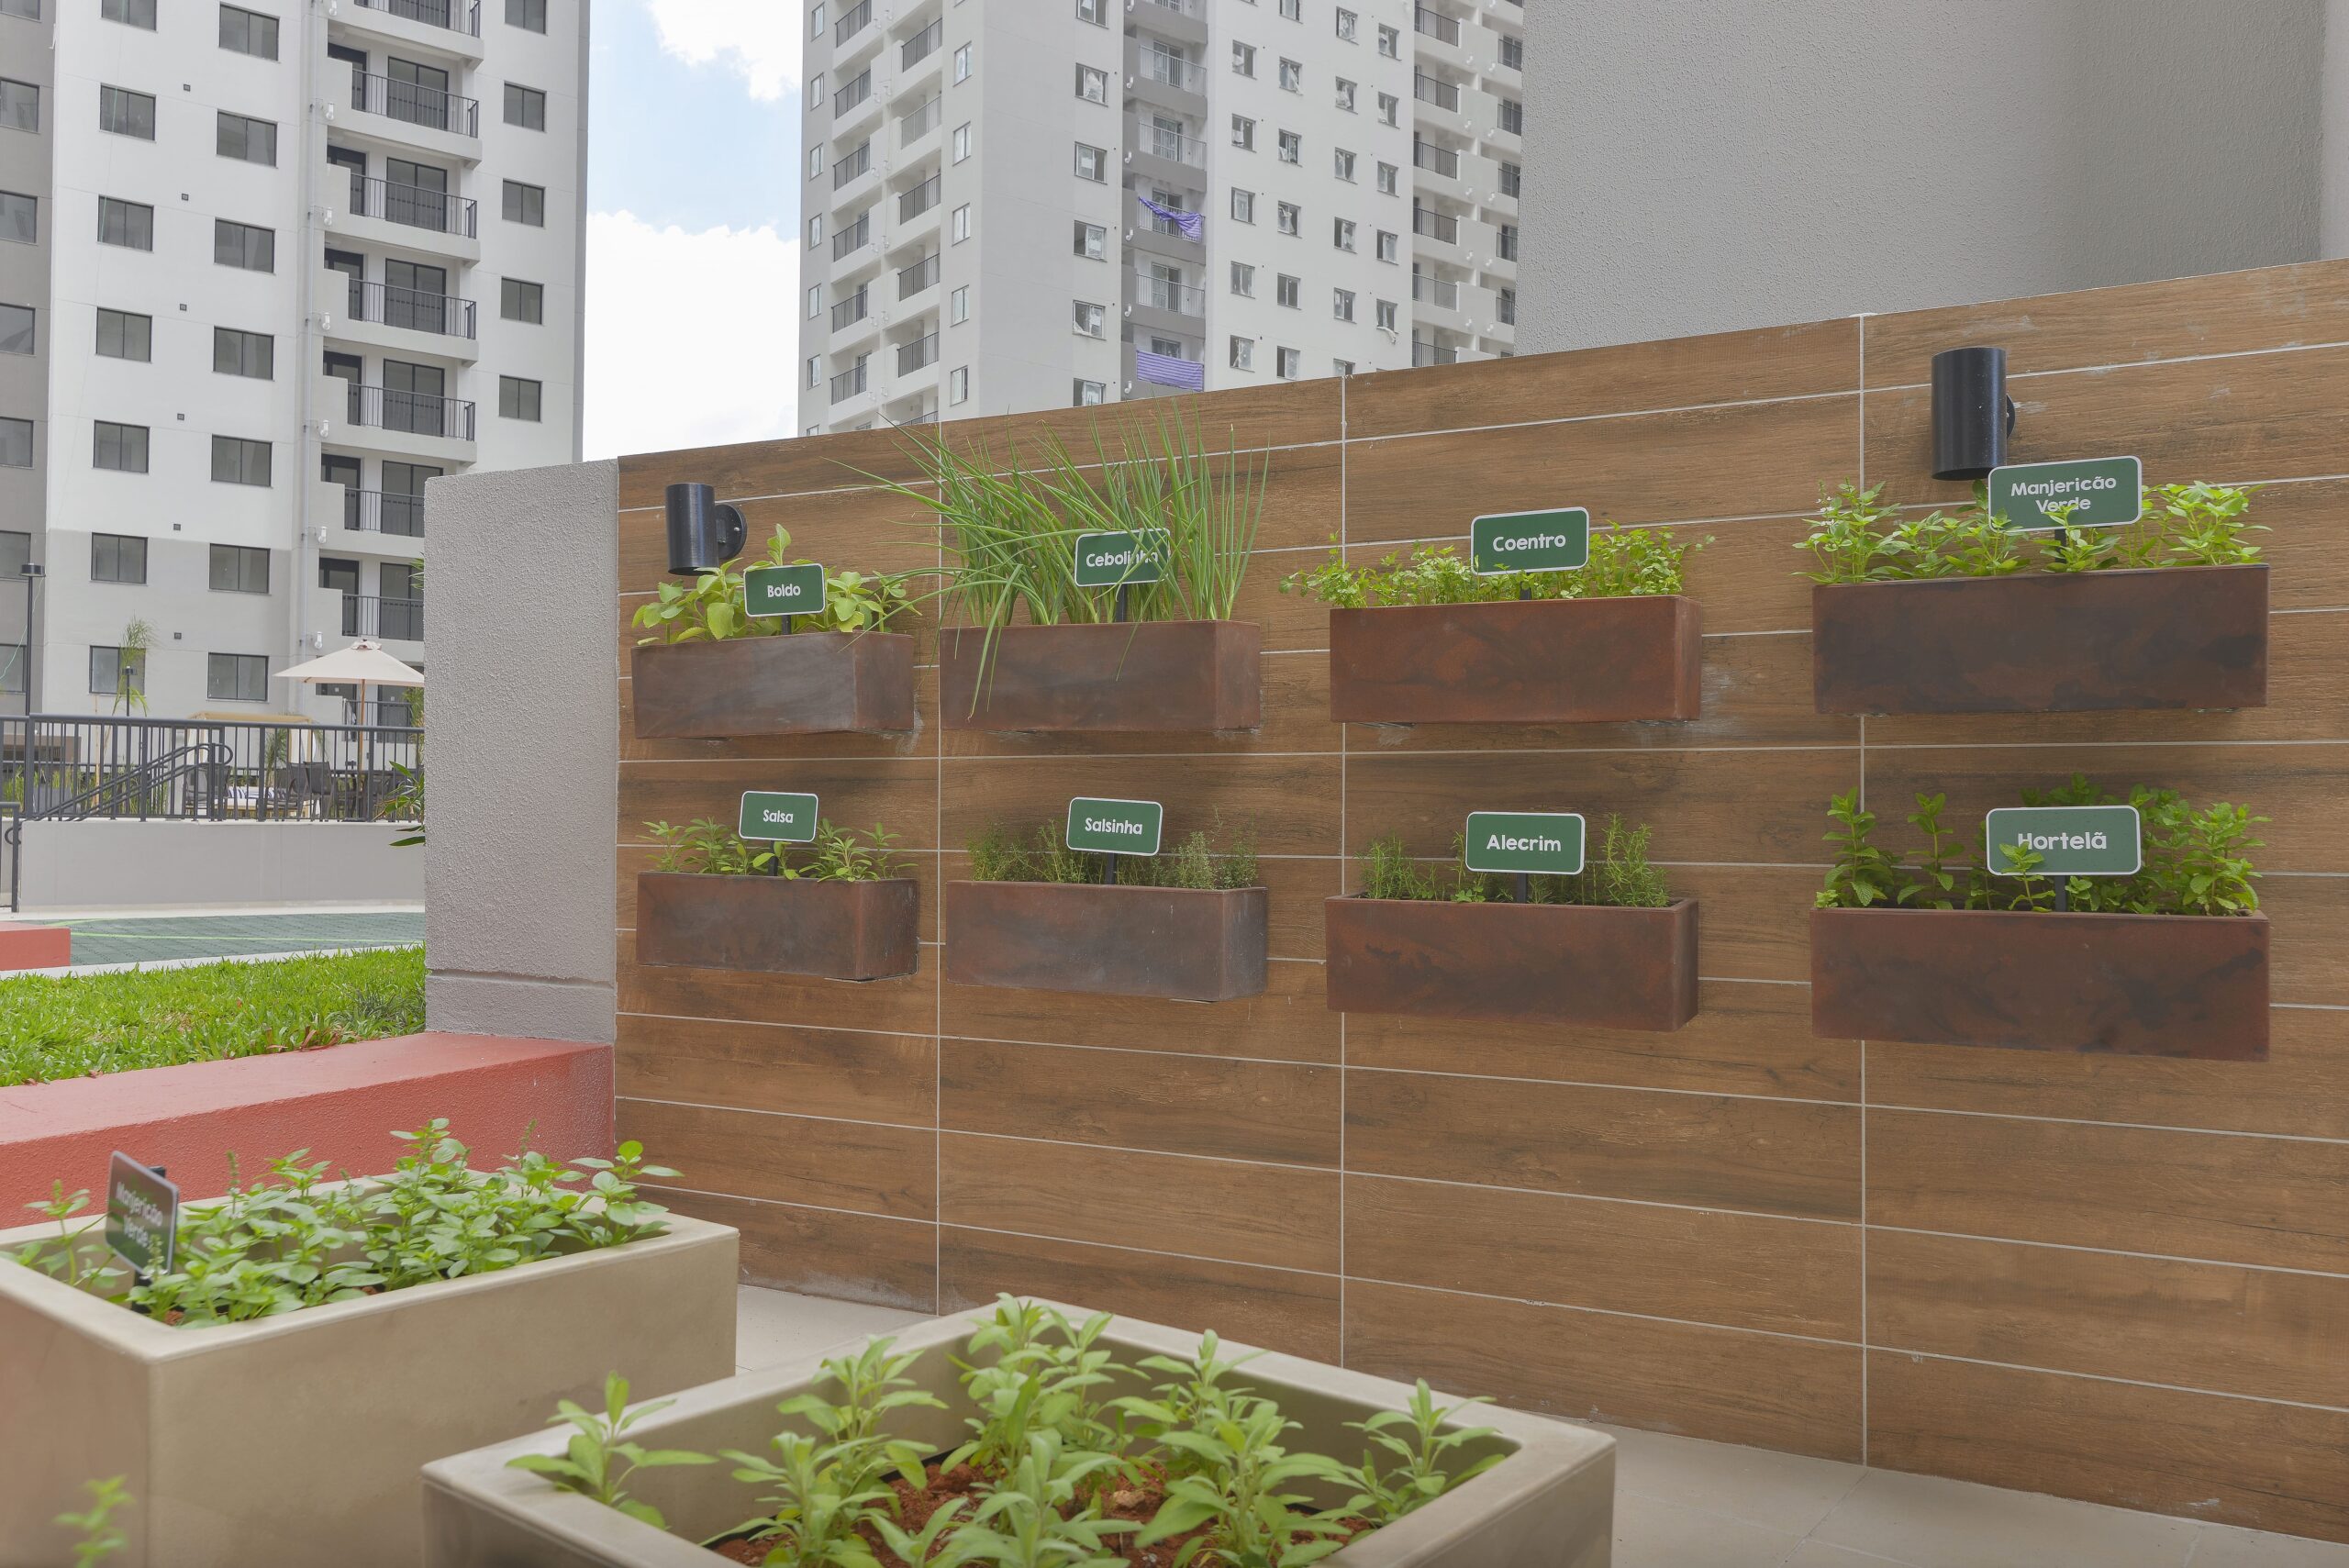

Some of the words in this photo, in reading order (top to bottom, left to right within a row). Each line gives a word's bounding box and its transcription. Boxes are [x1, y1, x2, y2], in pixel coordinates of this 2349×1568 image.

[2010, 476, 2117, 496] Manjericão
[1492, 533, 1566, 551] Coentro
[767, 584, 801, 598] Boldo
[763, 809, 794, 823] Salsa
[1085, 817, 1143, 835] Salsinha
[1486, 834, 1562, 852] Alecrim
[2018, 831, 2107, 850] Hortelã
